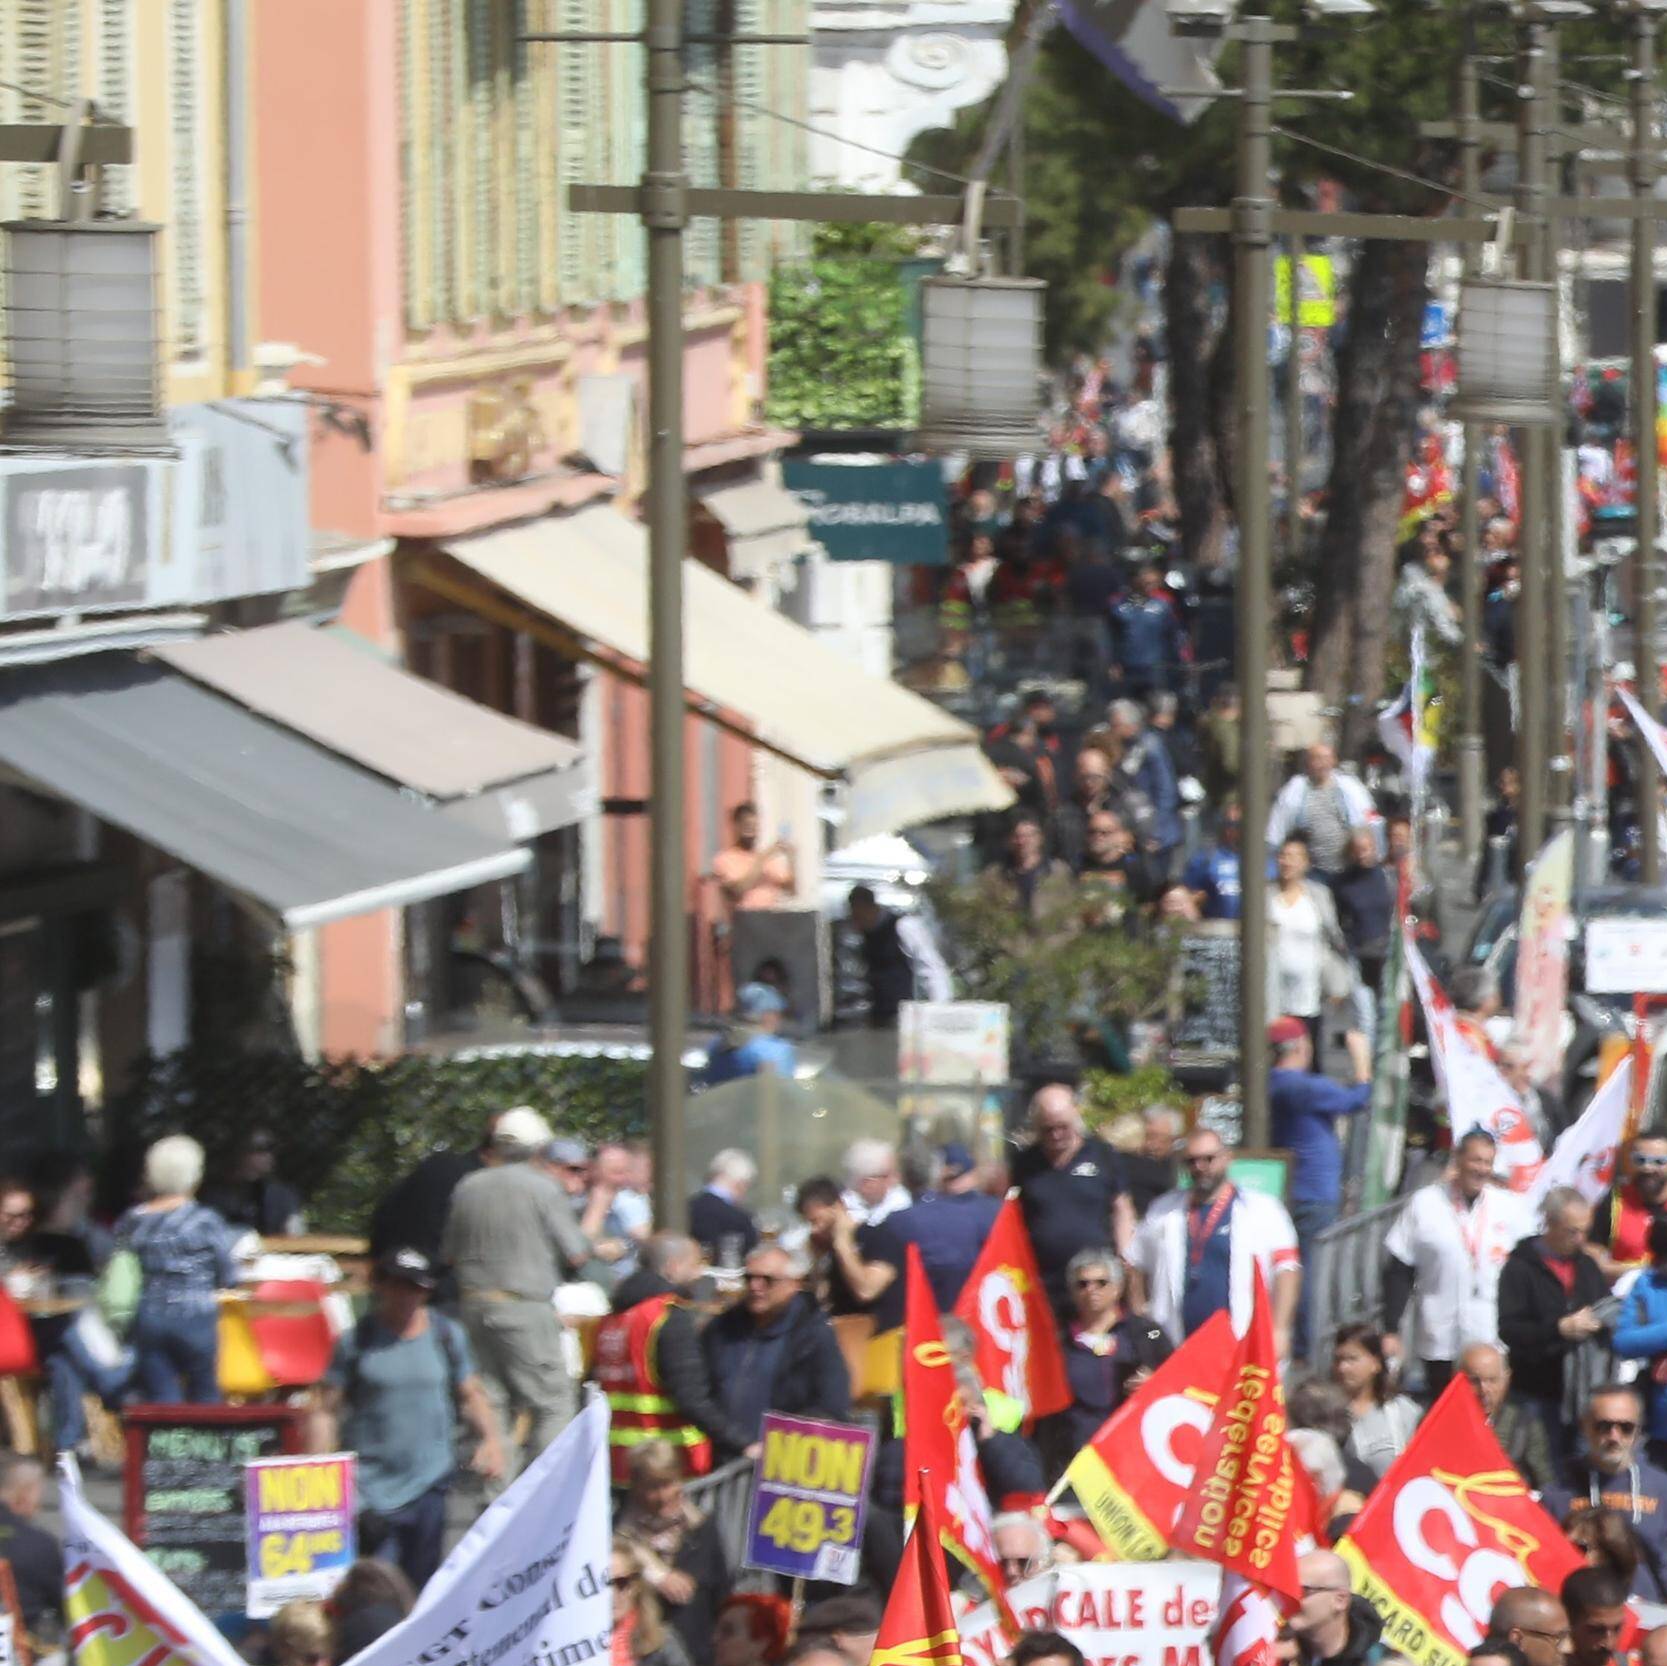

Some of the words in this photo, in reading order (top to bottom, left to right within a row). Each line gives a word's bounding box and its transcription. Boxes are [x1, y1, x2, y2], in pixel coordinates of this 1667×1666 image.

[258, 1462, 344, 1513] NON
[762, 1428, 866, 1495] NON
[758, 1496, 857, 1553] 49.3
